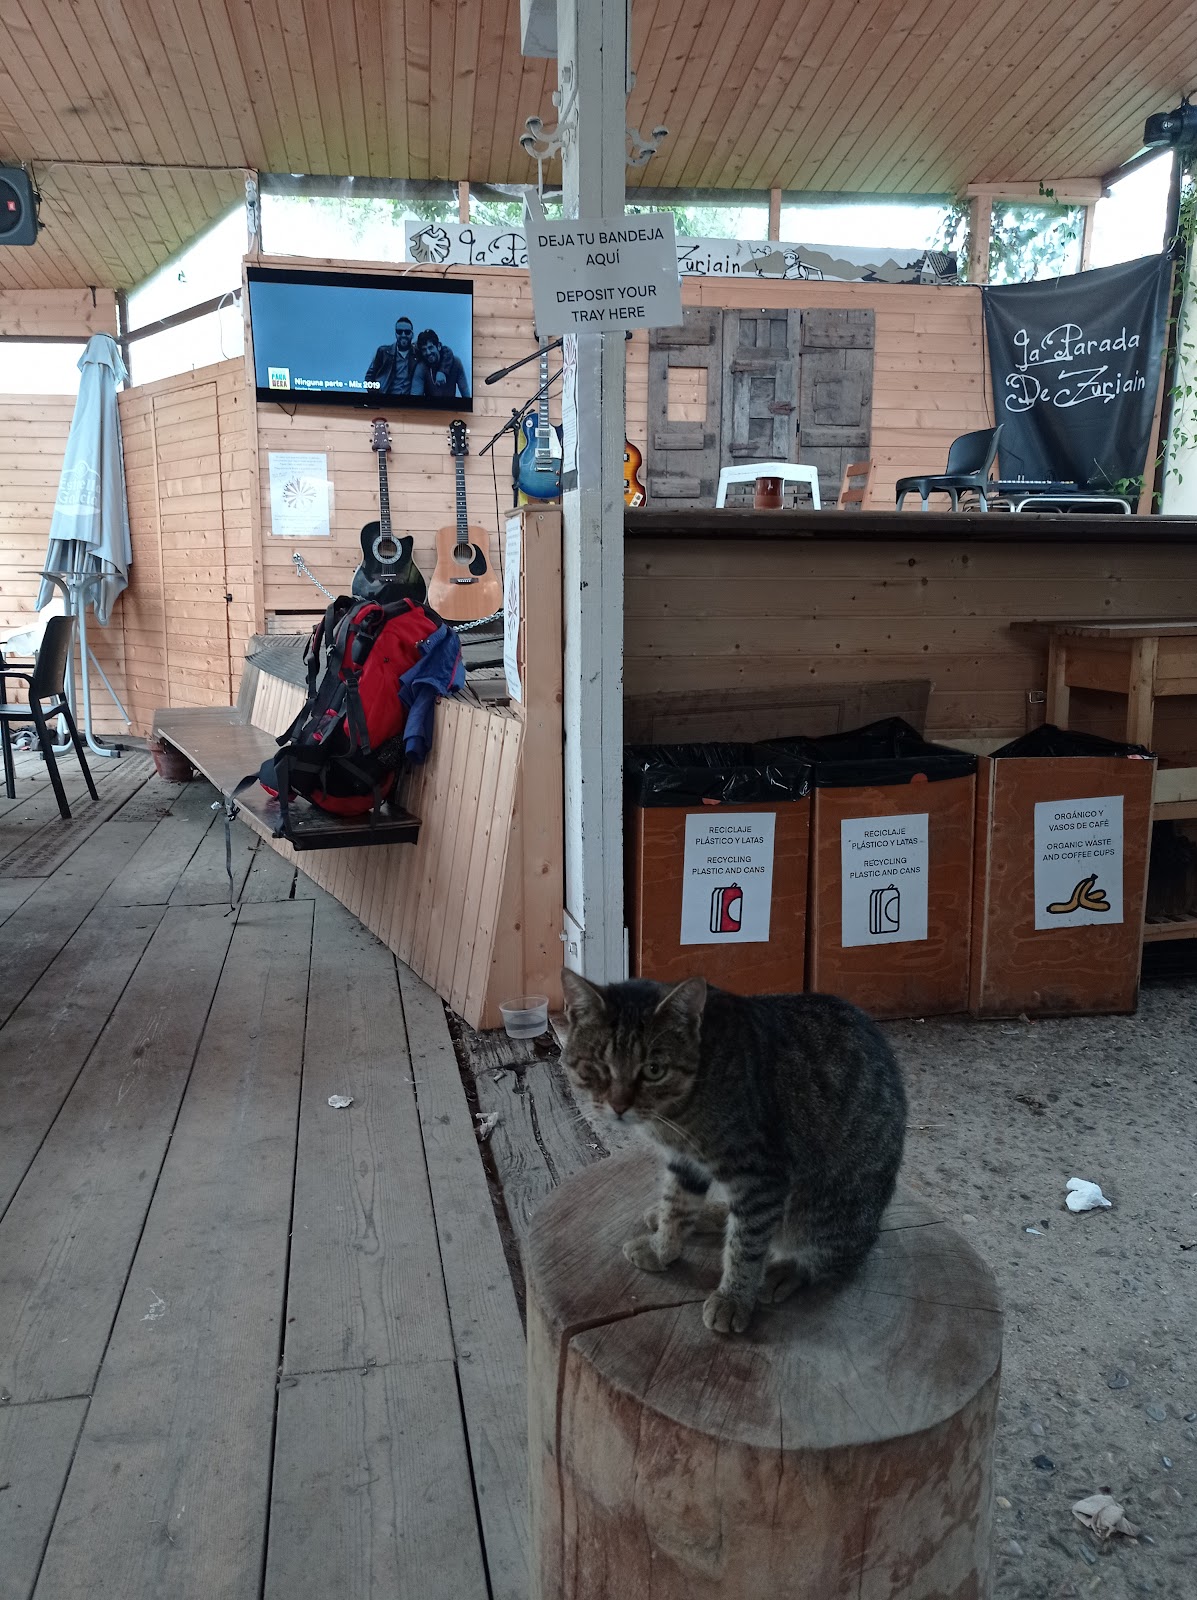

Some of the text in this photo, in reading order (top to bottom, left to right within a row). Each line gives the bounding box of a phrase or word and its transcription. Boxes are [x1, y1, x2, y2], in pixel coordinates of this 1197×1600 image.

[538, 228, 664, 247] DEJA TU BANDEJA
[586, 249, 620, 267] AQUÍ
[556, 285, 657, 303] DEPOSIT YOUR
[571, 306, 645, 322] TRAY HERE
[1013, 323, 1140, 371] La Parada
[294, 377, 324, 388] Ninguna
[348, 380, 362, 388] Mix
[363, 381, 381, 390] 2019
[1005, 365, 1146, 412] De Zuriain
[1054, 809, 1104, 821] ORGÁNICO Y
[709, 826, 752, 834] RECICLAJE
[1048, 823, 1075, 832] VASOS
[1088, 819, 1109, 829] CAFÉ
[864, 828, 906, 838] RECICLAJE
[695, 836, 733, 845] PLÁSTICO
[741, 836, 764, 844] LATAS
[851, 840, 889, 850] PLÁSTICO
[896, 837, 918, 846] LATAS
[1046, 838, 1112, 850] ORGANIC WASTE
[707, 856, 752, 864] RECYCLING
[1042, 848, 1115, 861] AND COFFEE CUPS
[863, 857, 907, 867] RECYCLING
[692, 867, 724, 875] PLASTIC
[743, 866, 765, 874] CANS
[849, 866, 921, 879] PLASTIC AND CANS
